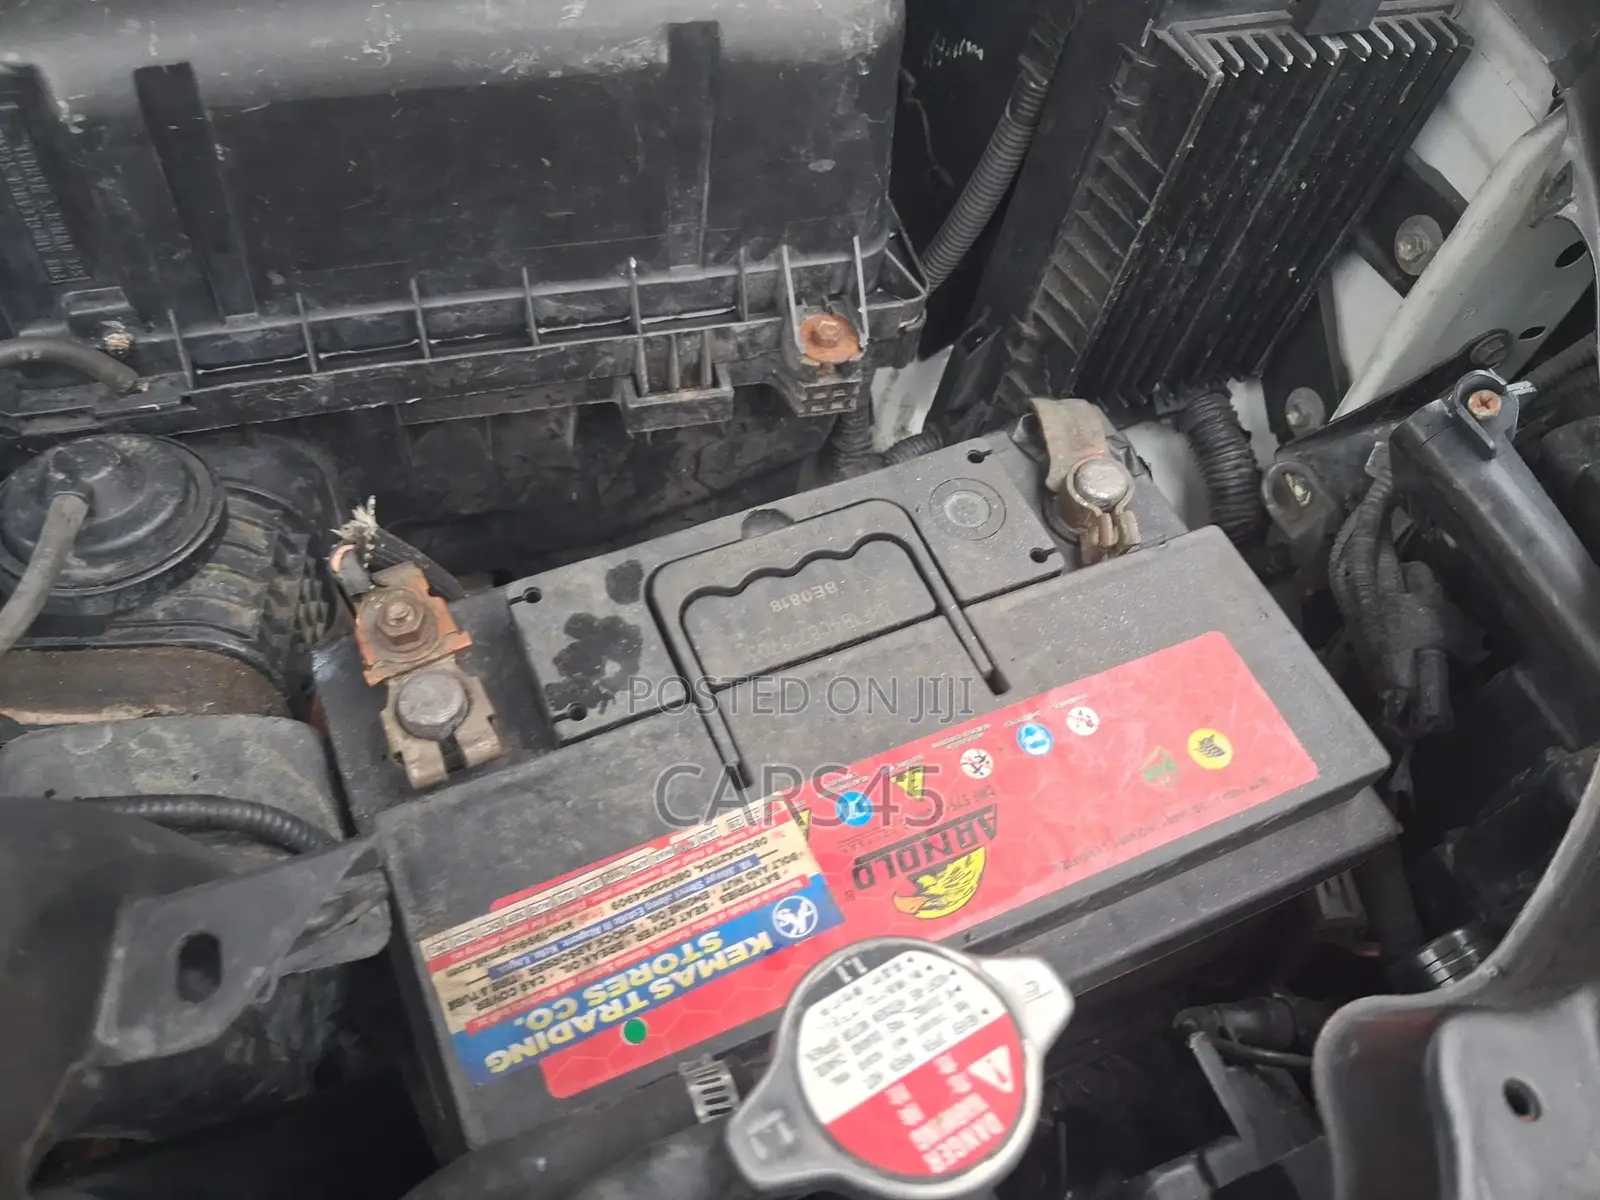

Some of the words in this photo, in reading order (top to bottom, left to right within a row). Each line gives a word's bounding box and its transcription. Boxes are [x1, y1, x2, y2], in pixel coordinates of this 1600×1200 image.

[852, 803, 998, 890] ARNOLD
[677, 902, 710, 923] SEAT
[718, 870, 781, 905] BATTERIES
[633, 916, 678, 943] COVER
[579, 928, 726, 1008] STORES
[645, 929, 774, 1002] KEMAS
[482, 985, 649, 1076] TRADING
[511, 992, 581, 1039] CO.
